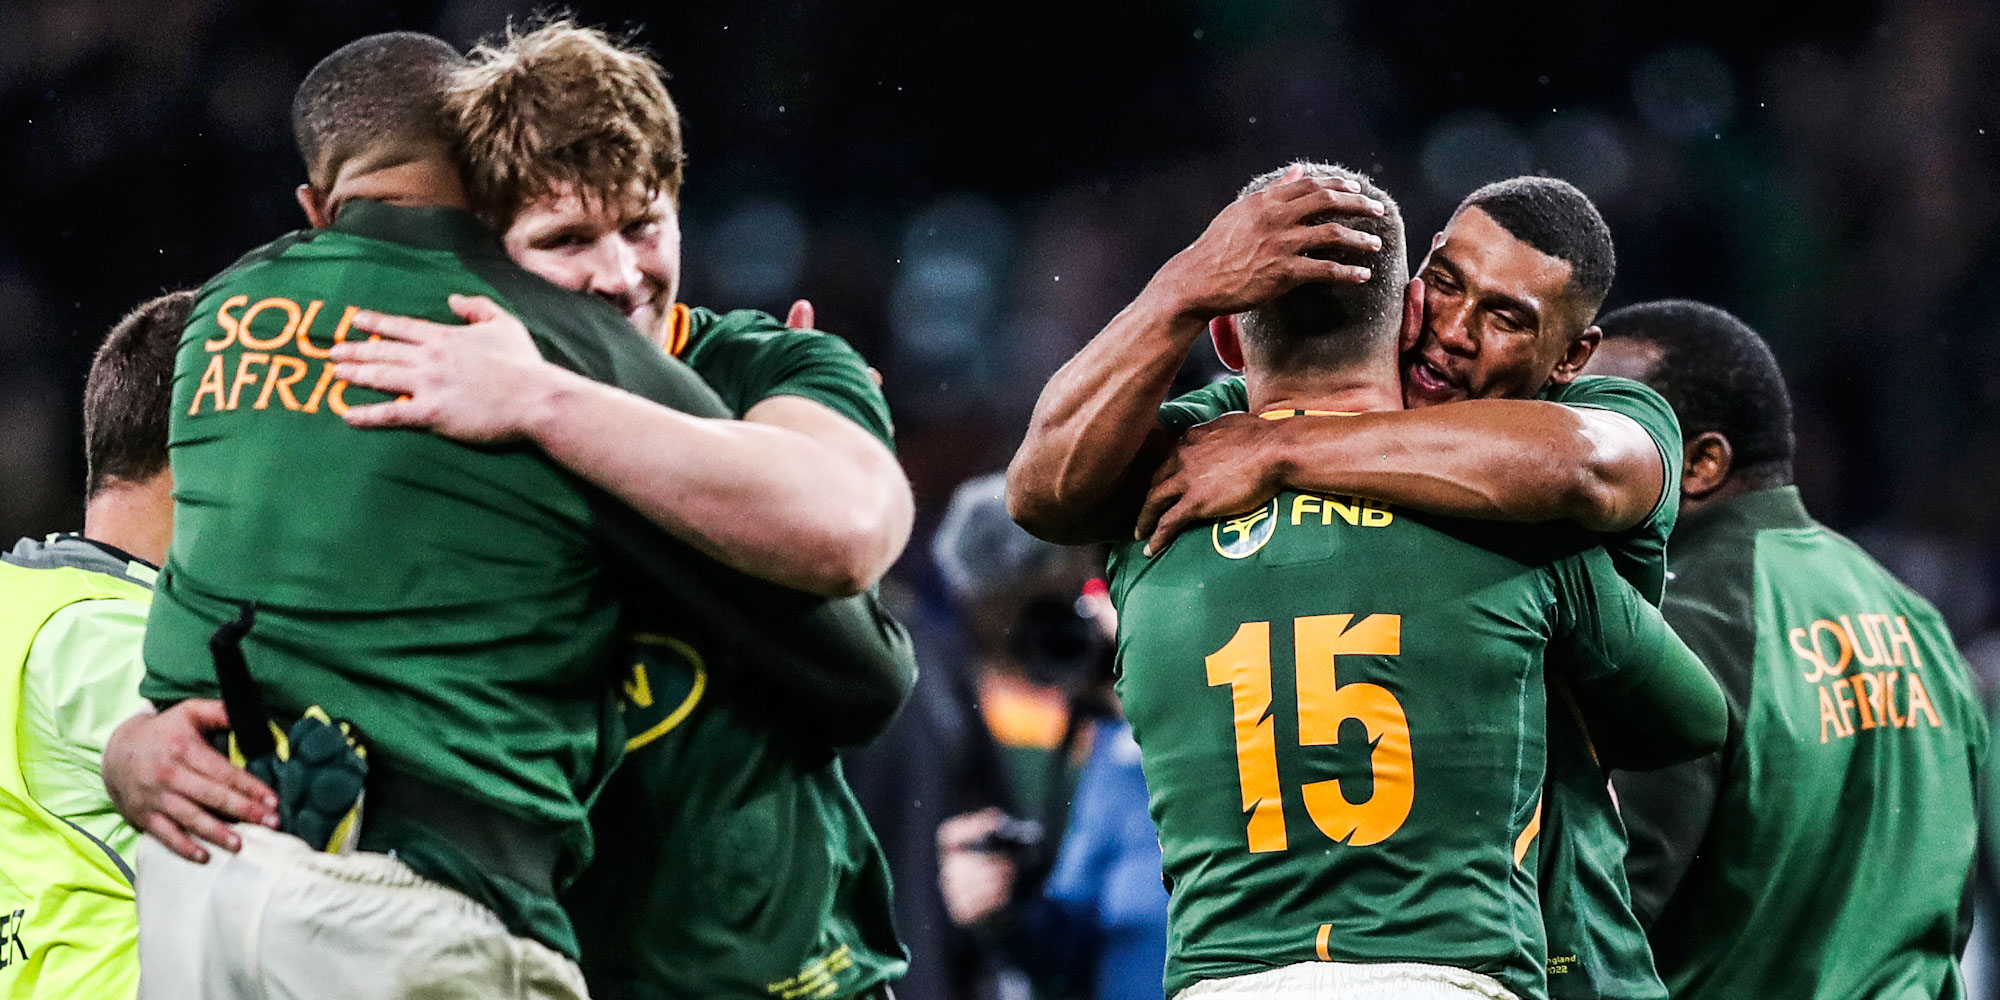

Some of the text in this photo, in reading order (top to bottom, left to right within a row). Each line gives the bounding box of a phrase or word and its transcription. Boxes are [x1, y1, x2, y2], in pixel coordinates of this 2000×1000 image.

[205, 295, 382, 359] SOU
[188, 352, 402, 416] AFRIC
[1291, 494, 1393, 527] FNB
[1788, 614, 1923, 683] SOUTH
[1204, 613, 1415, 854] 15
[1818, 670, 1942, 744] AFRICA
[0, 909, 29, 970] ER
[1547, 954, 1577, 965] ngland
[1547, 965, 1568, 974] 022
